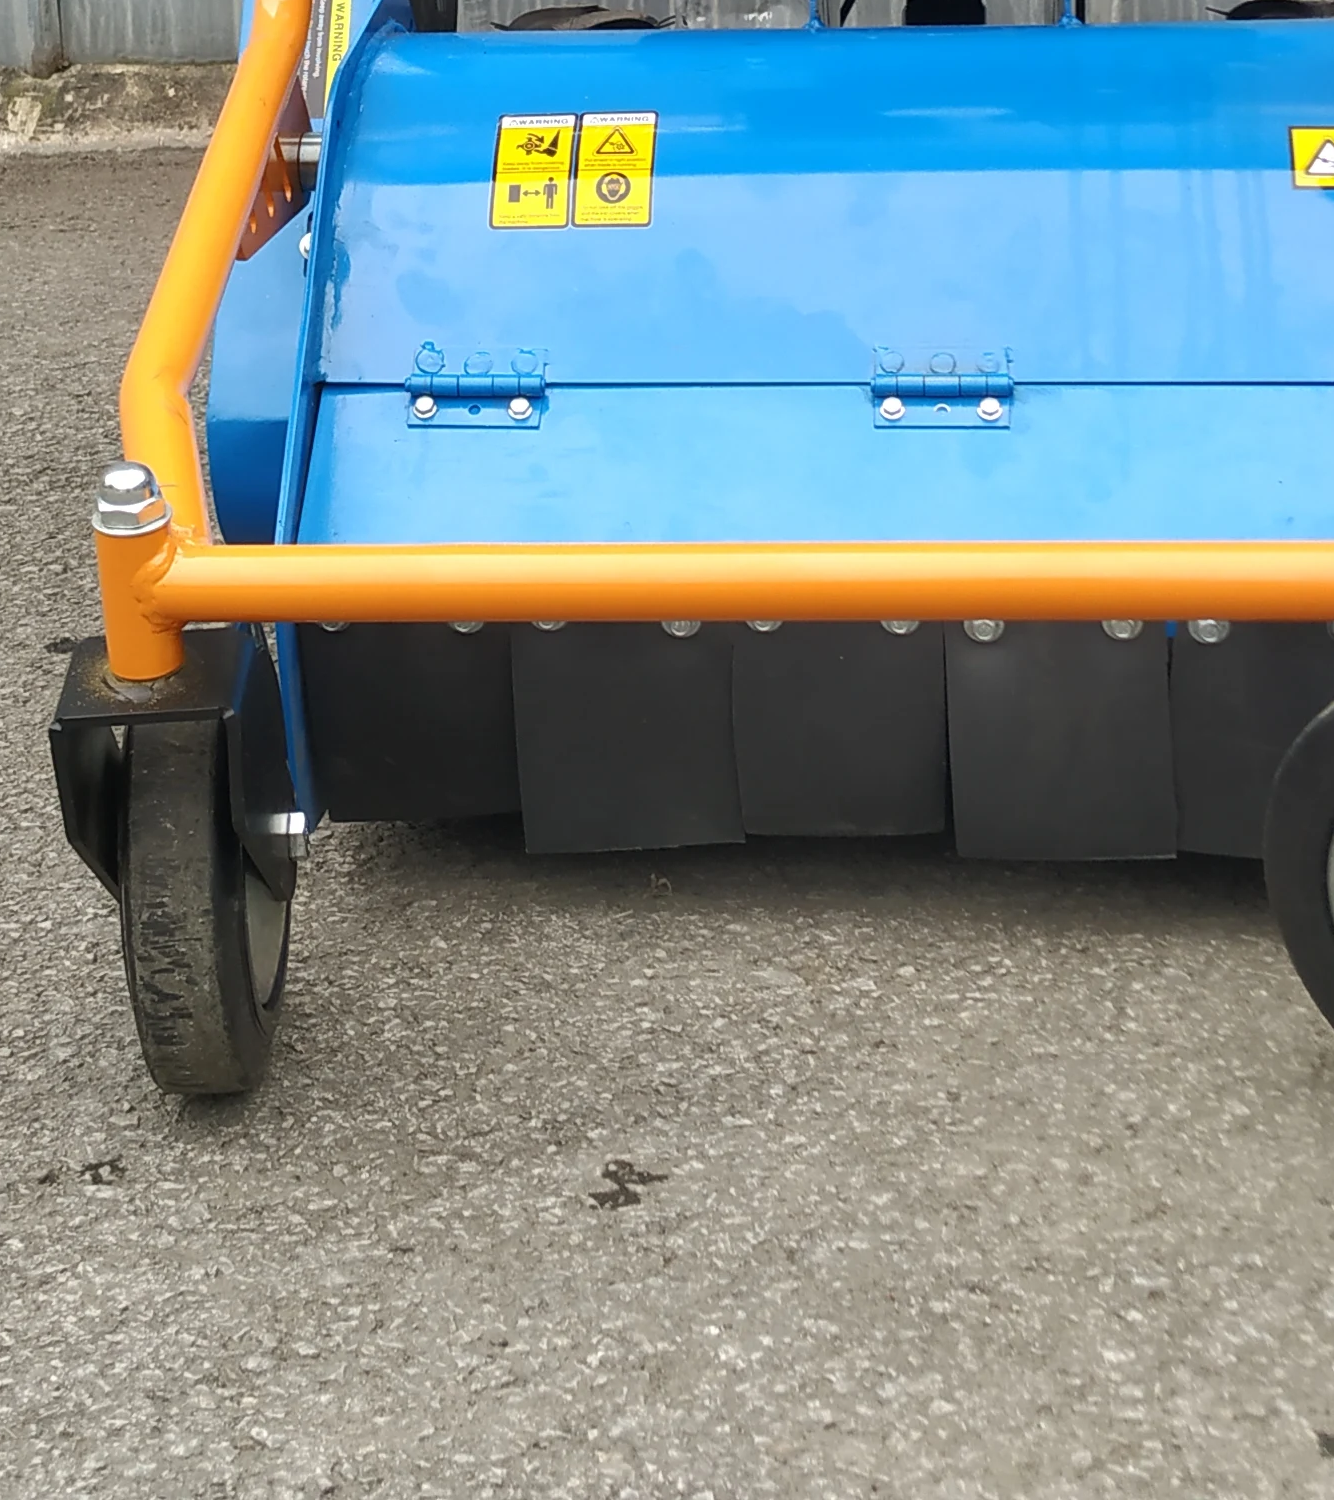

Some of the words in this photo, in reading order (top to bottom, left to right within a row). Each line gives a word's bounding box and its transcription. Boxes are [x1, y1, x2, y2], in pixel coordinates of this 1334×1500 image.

[332, 2, 346, 62] WARNING
[519, 118, 569, 126] WARNING
[599, 115, 649, 123] WARNING
